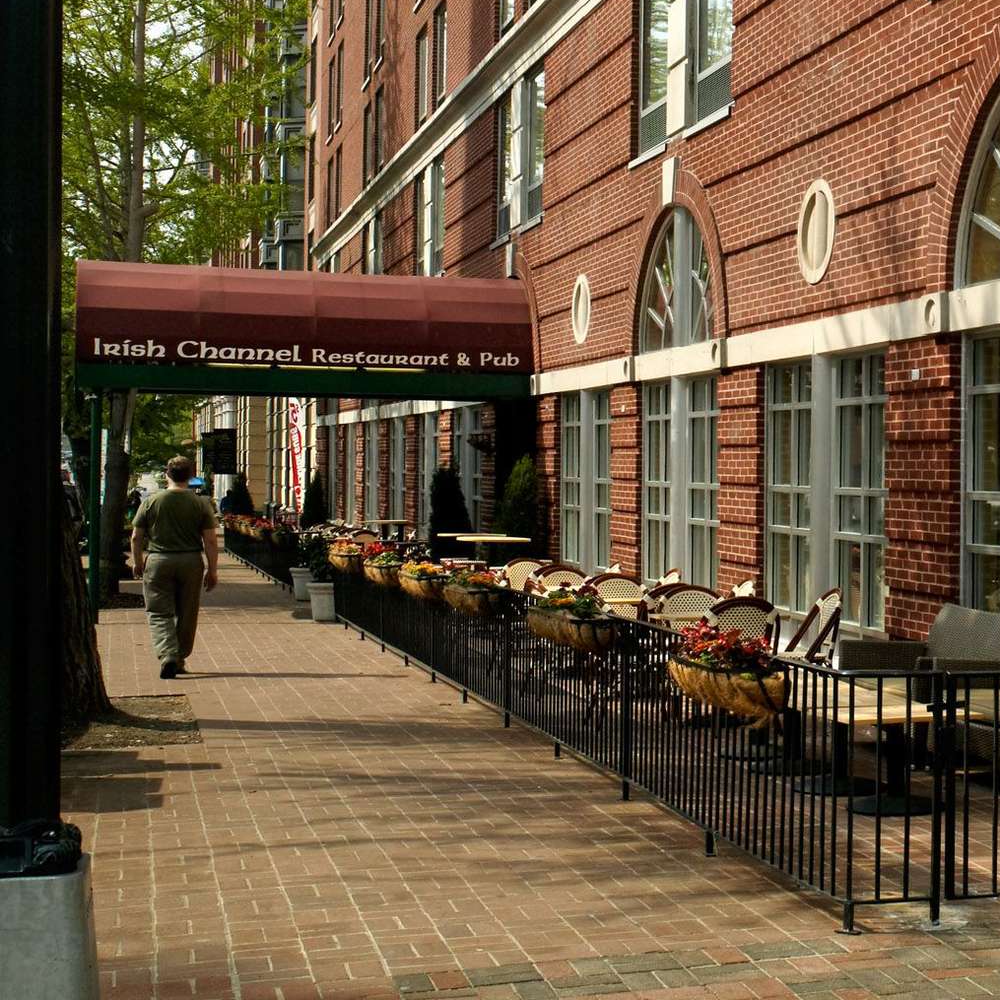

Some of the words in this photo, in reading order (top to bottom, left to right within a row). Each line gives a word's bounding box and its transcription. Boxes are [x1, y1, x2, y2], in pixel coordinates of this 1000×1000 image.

[177, 340, 302, 362] Channel
[312, 348, 449, 366] Restaurant
[457, 352, 471, 367] &
[480, 352, 520, 367] Pub
